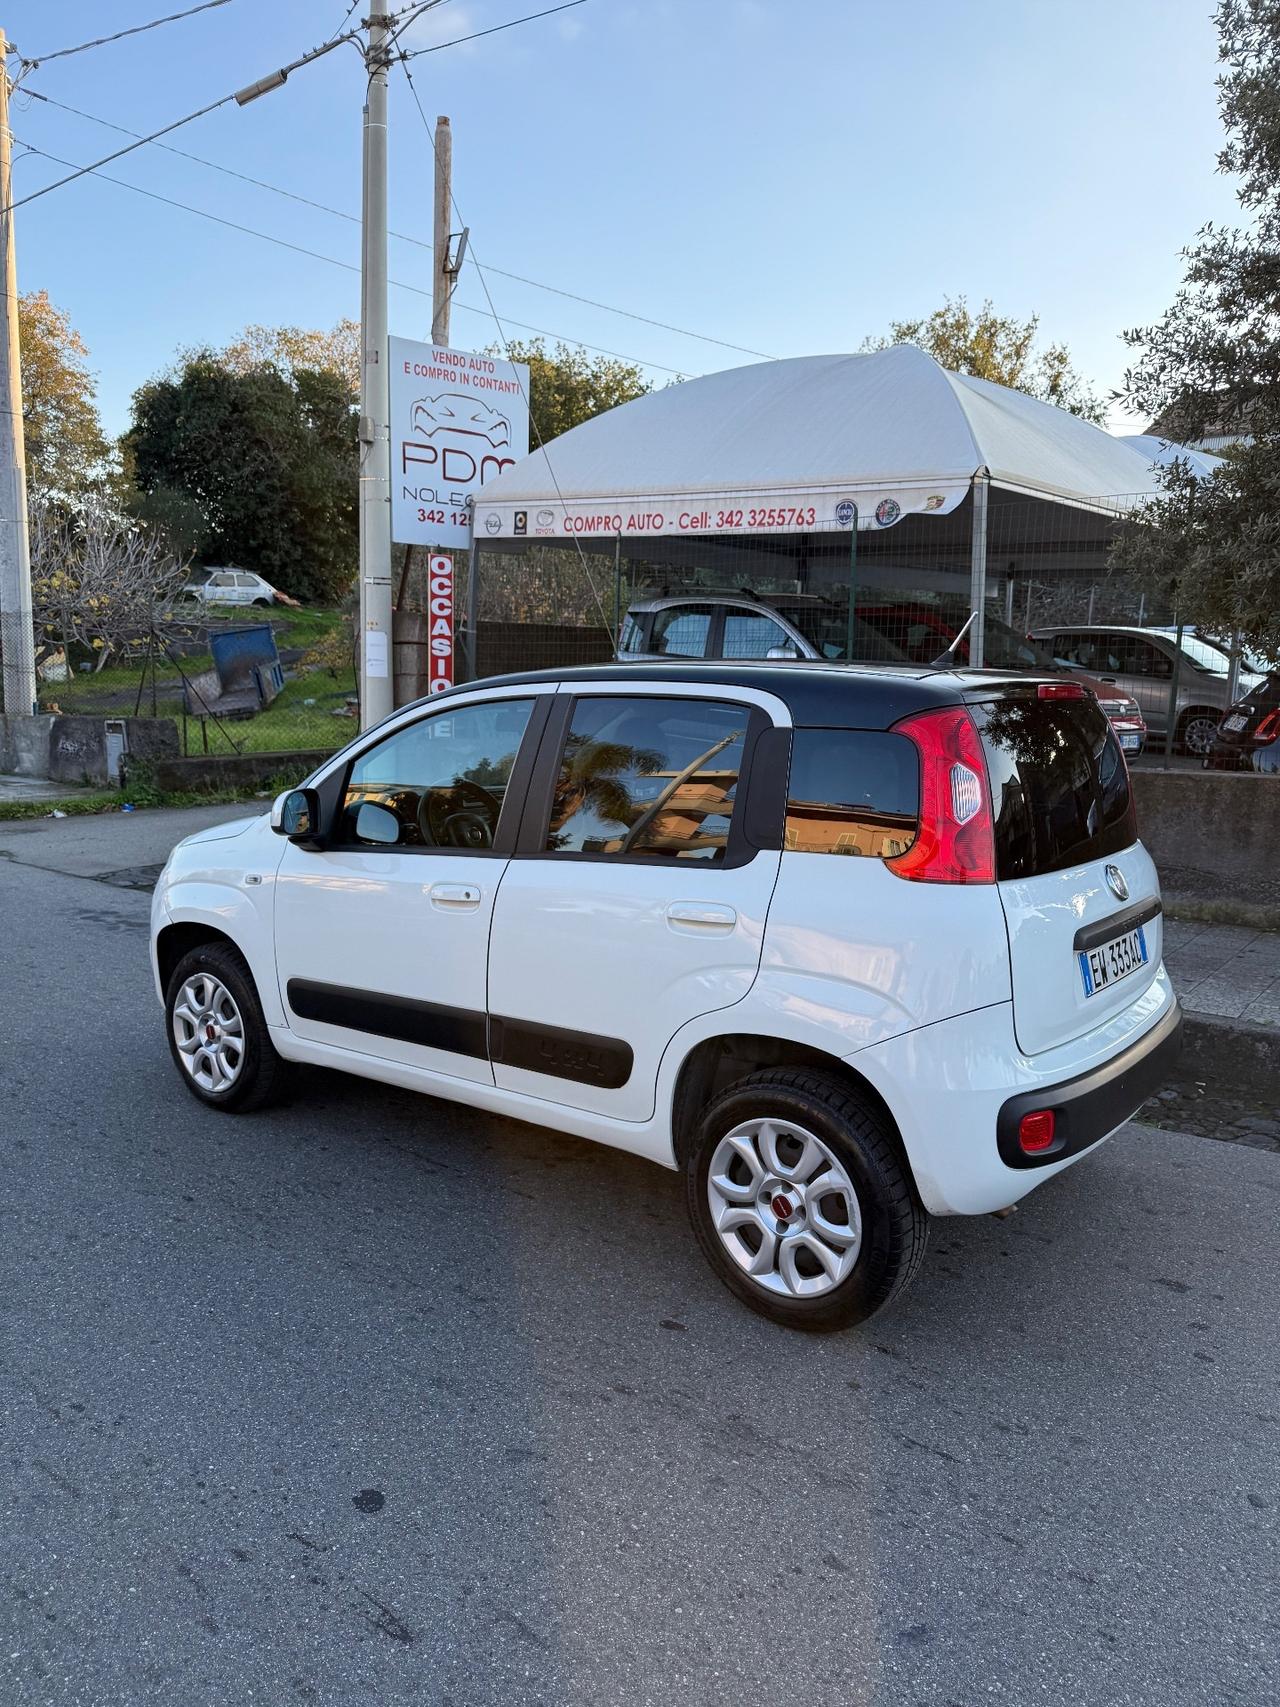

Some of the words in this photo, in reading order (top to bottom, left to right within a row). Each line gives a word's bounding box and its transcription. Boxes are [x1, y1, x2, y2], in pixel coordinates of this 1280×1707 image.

[432, 350, 466, 367] VENDO
[469, 358, 495, 373] AUTO
[404, 361, 411, 374] E
[413, 363, 457, 383] COMPRO
[459, 373, 470, 385] IN
[472, 375, 520, 395] CONTANTI
[417, 508, 445, 524] 342
[563, 514, 623, 532] COMPRO
[626, 513, 664, 530] AUTO
[678, 511, 712, 529] Cell:
[716, 510, 744, 528] 342
[747, 507, 816, 527] 3255763
